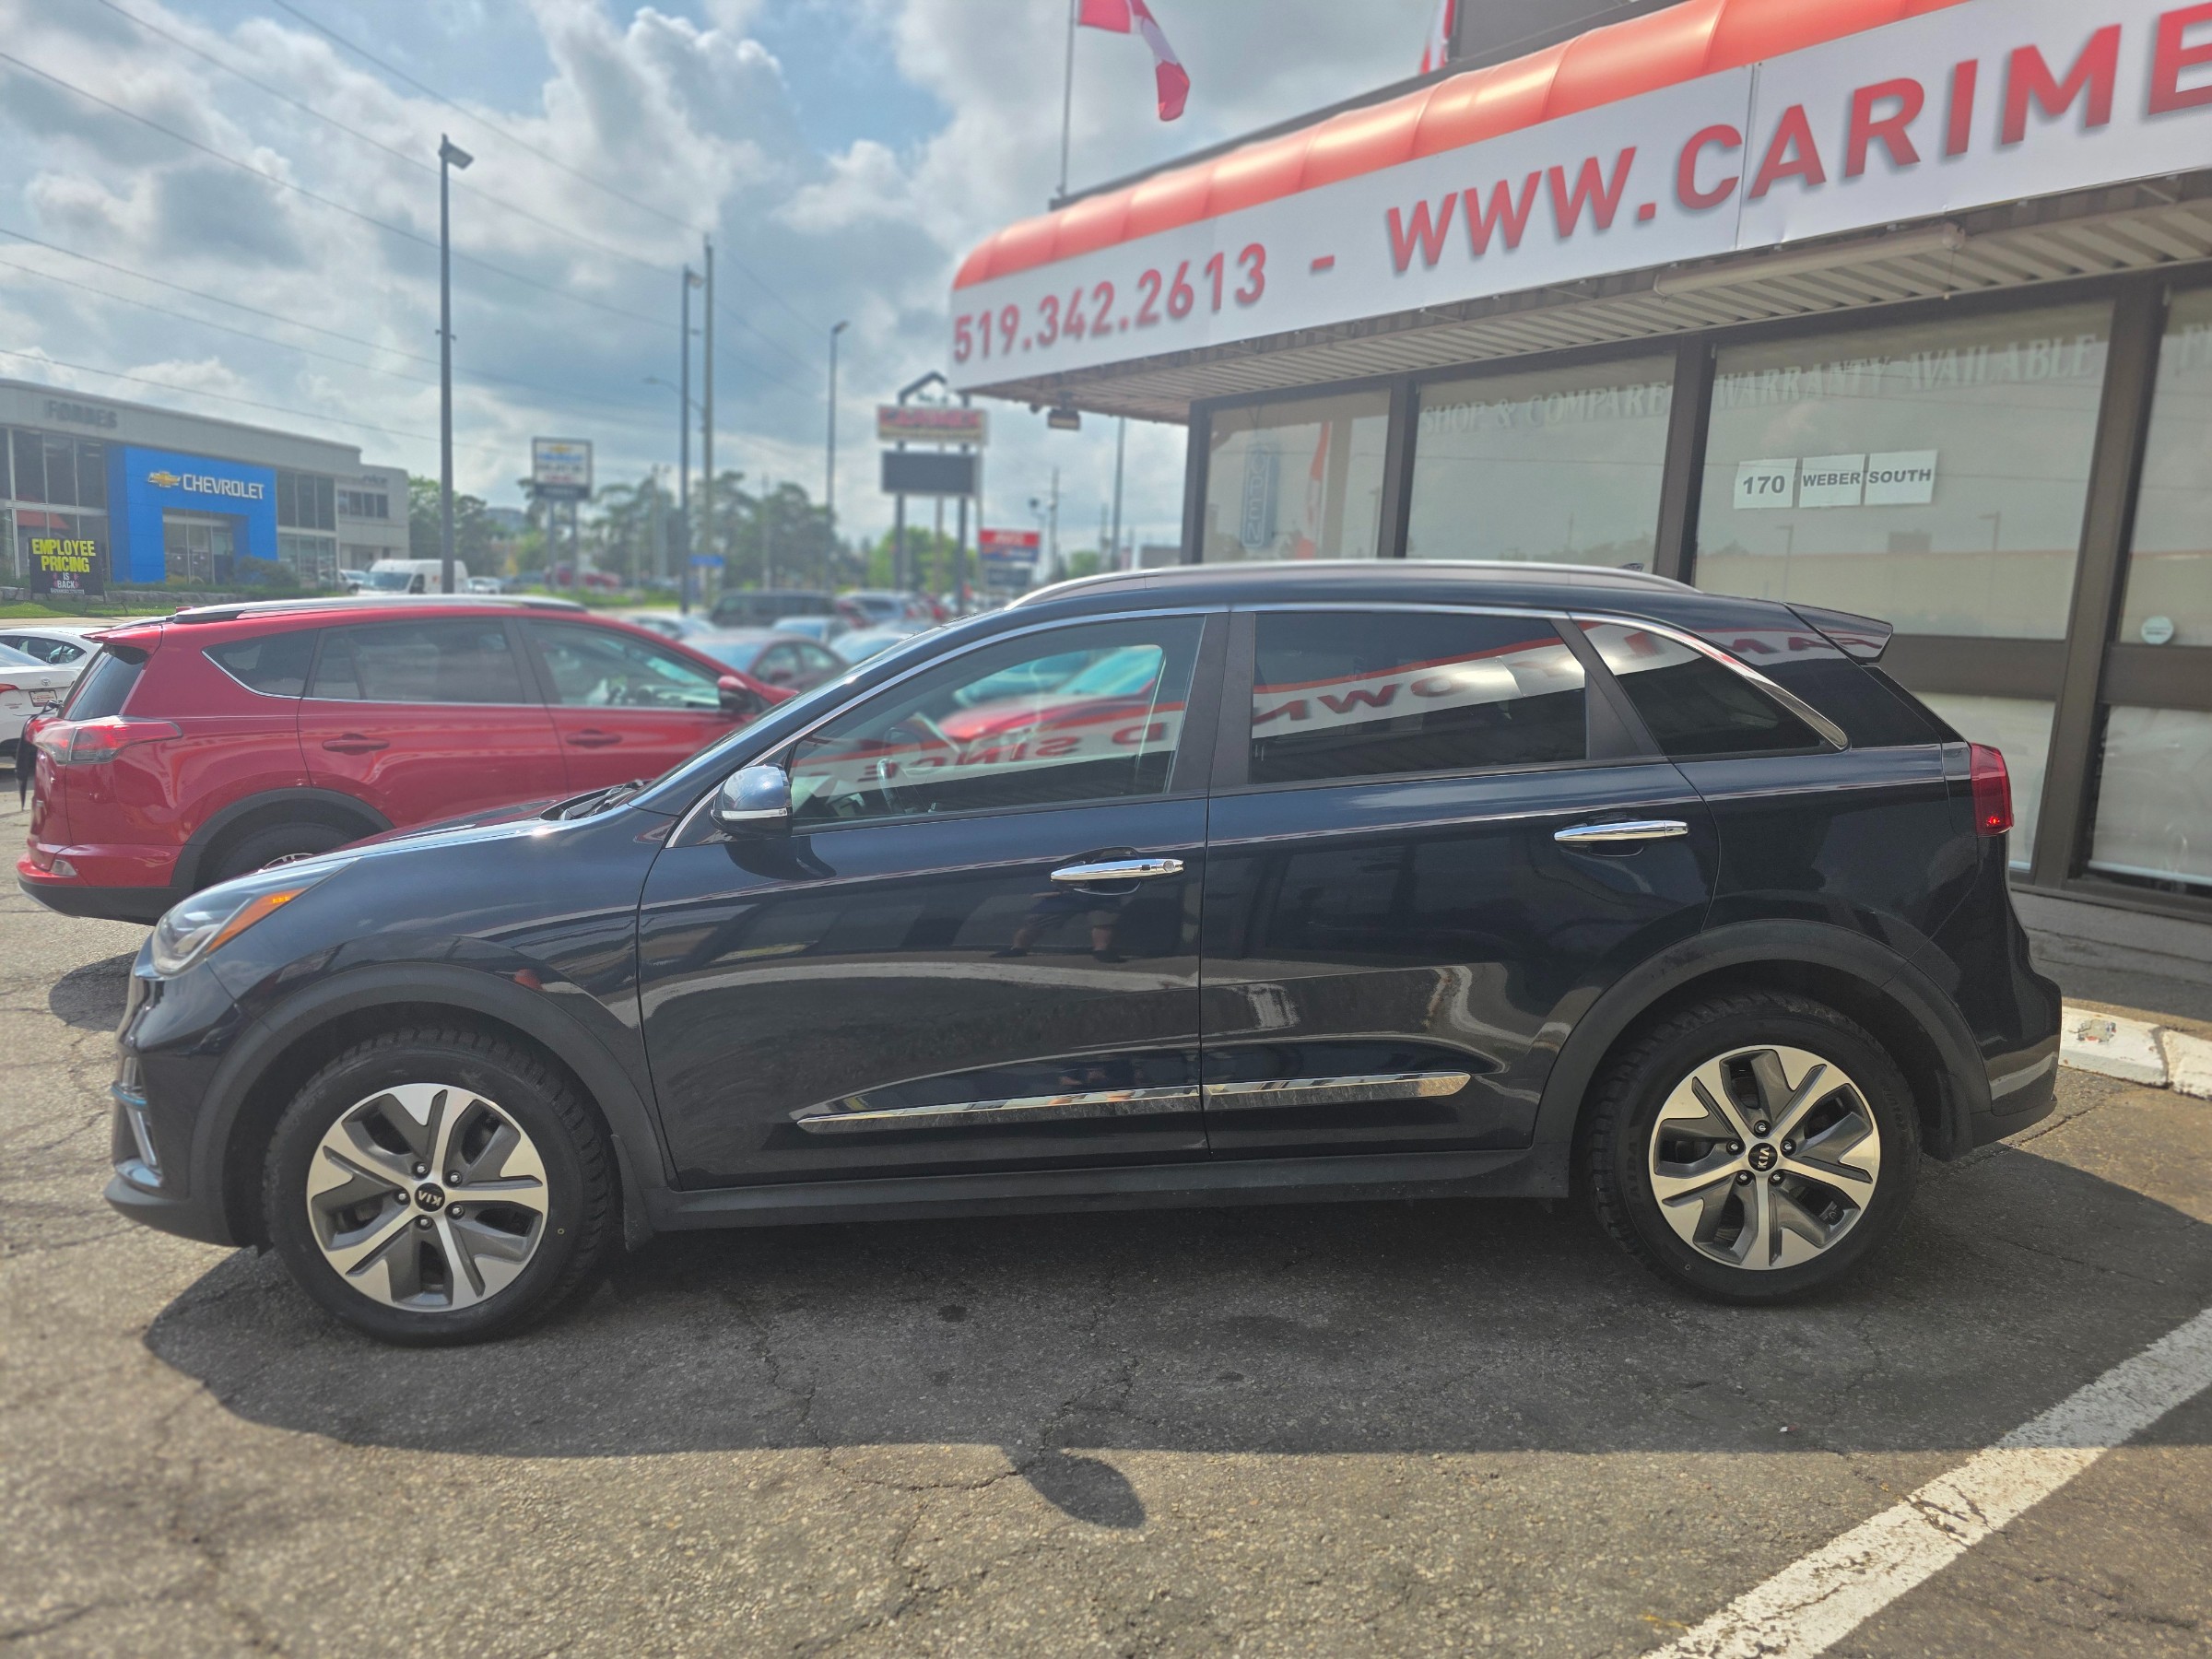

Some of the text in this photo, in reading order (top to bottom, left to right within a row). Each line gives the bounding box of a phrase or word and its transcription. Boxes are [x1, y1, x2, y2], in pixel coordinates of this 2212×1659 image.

[953, 242, 1267, 363] 519.342.2613
[1904, 334, 2098, 391] AVAILABLE
[1421, 401, 1486, 434] SHOP
[1525, 382, 1670, 428] COMPARE
[182, 474, 265, 500] CHEVROLET
[1743, 469, 1931, 494] 170 WEBER SOUTH
[1248, 449, 1266, 541] OPEN
[31, 538, 96, 557] EMPLOYEE
[41, 555, 90, 573] PRICING
[56, 580, 76, 589] BACK
[63, 572, 70, 581] IS
[1758, 1147, 1770, 1169] KIA
[418, 1190, 442, 1206] KIA
